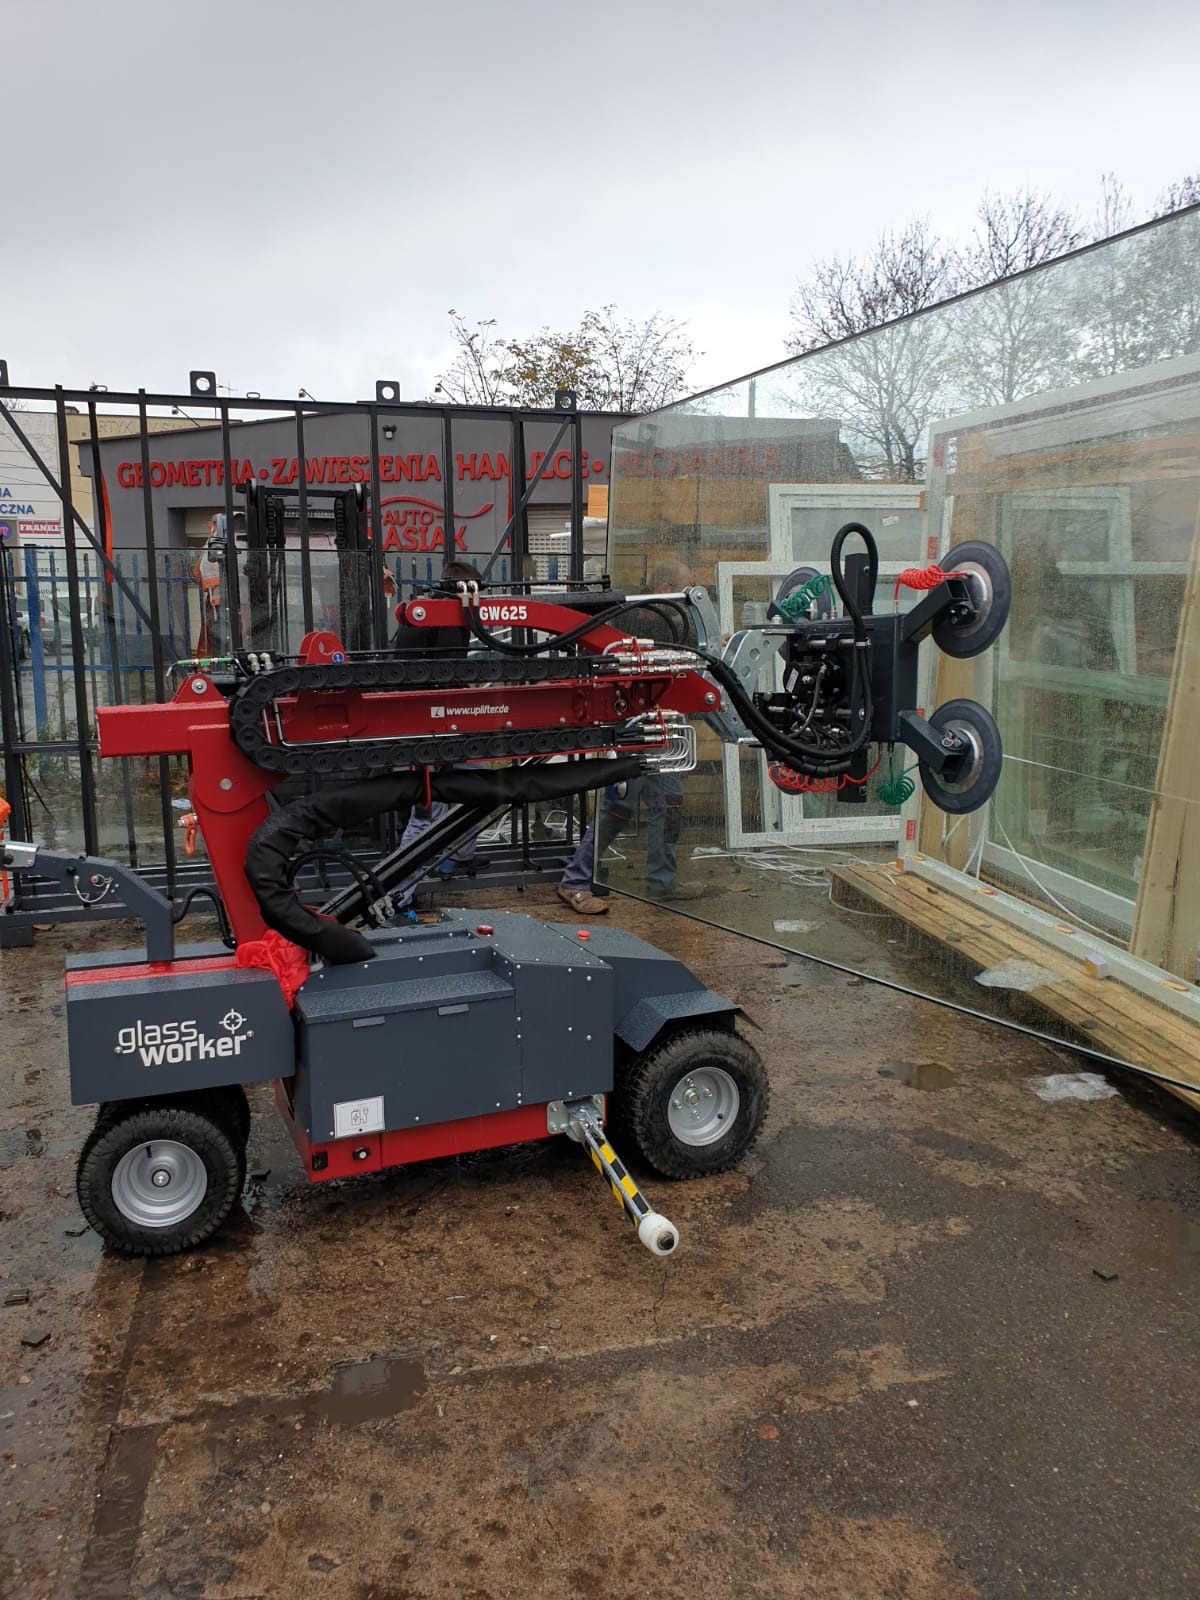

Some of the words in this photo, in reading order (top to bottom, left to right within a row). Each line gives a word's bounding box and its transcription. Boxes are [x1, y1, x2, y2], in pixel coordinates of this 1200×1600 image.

[116, 458, 254, 488] GEOMETRIA
[383, 509, 434, 526] AUTO
[479, 605, 528, 621] GW625
[446, 704, 510, 717] www.uplifter.de
[117, 1019, 199, 1054] glass
[139, 1033, 248, 1067] worker
